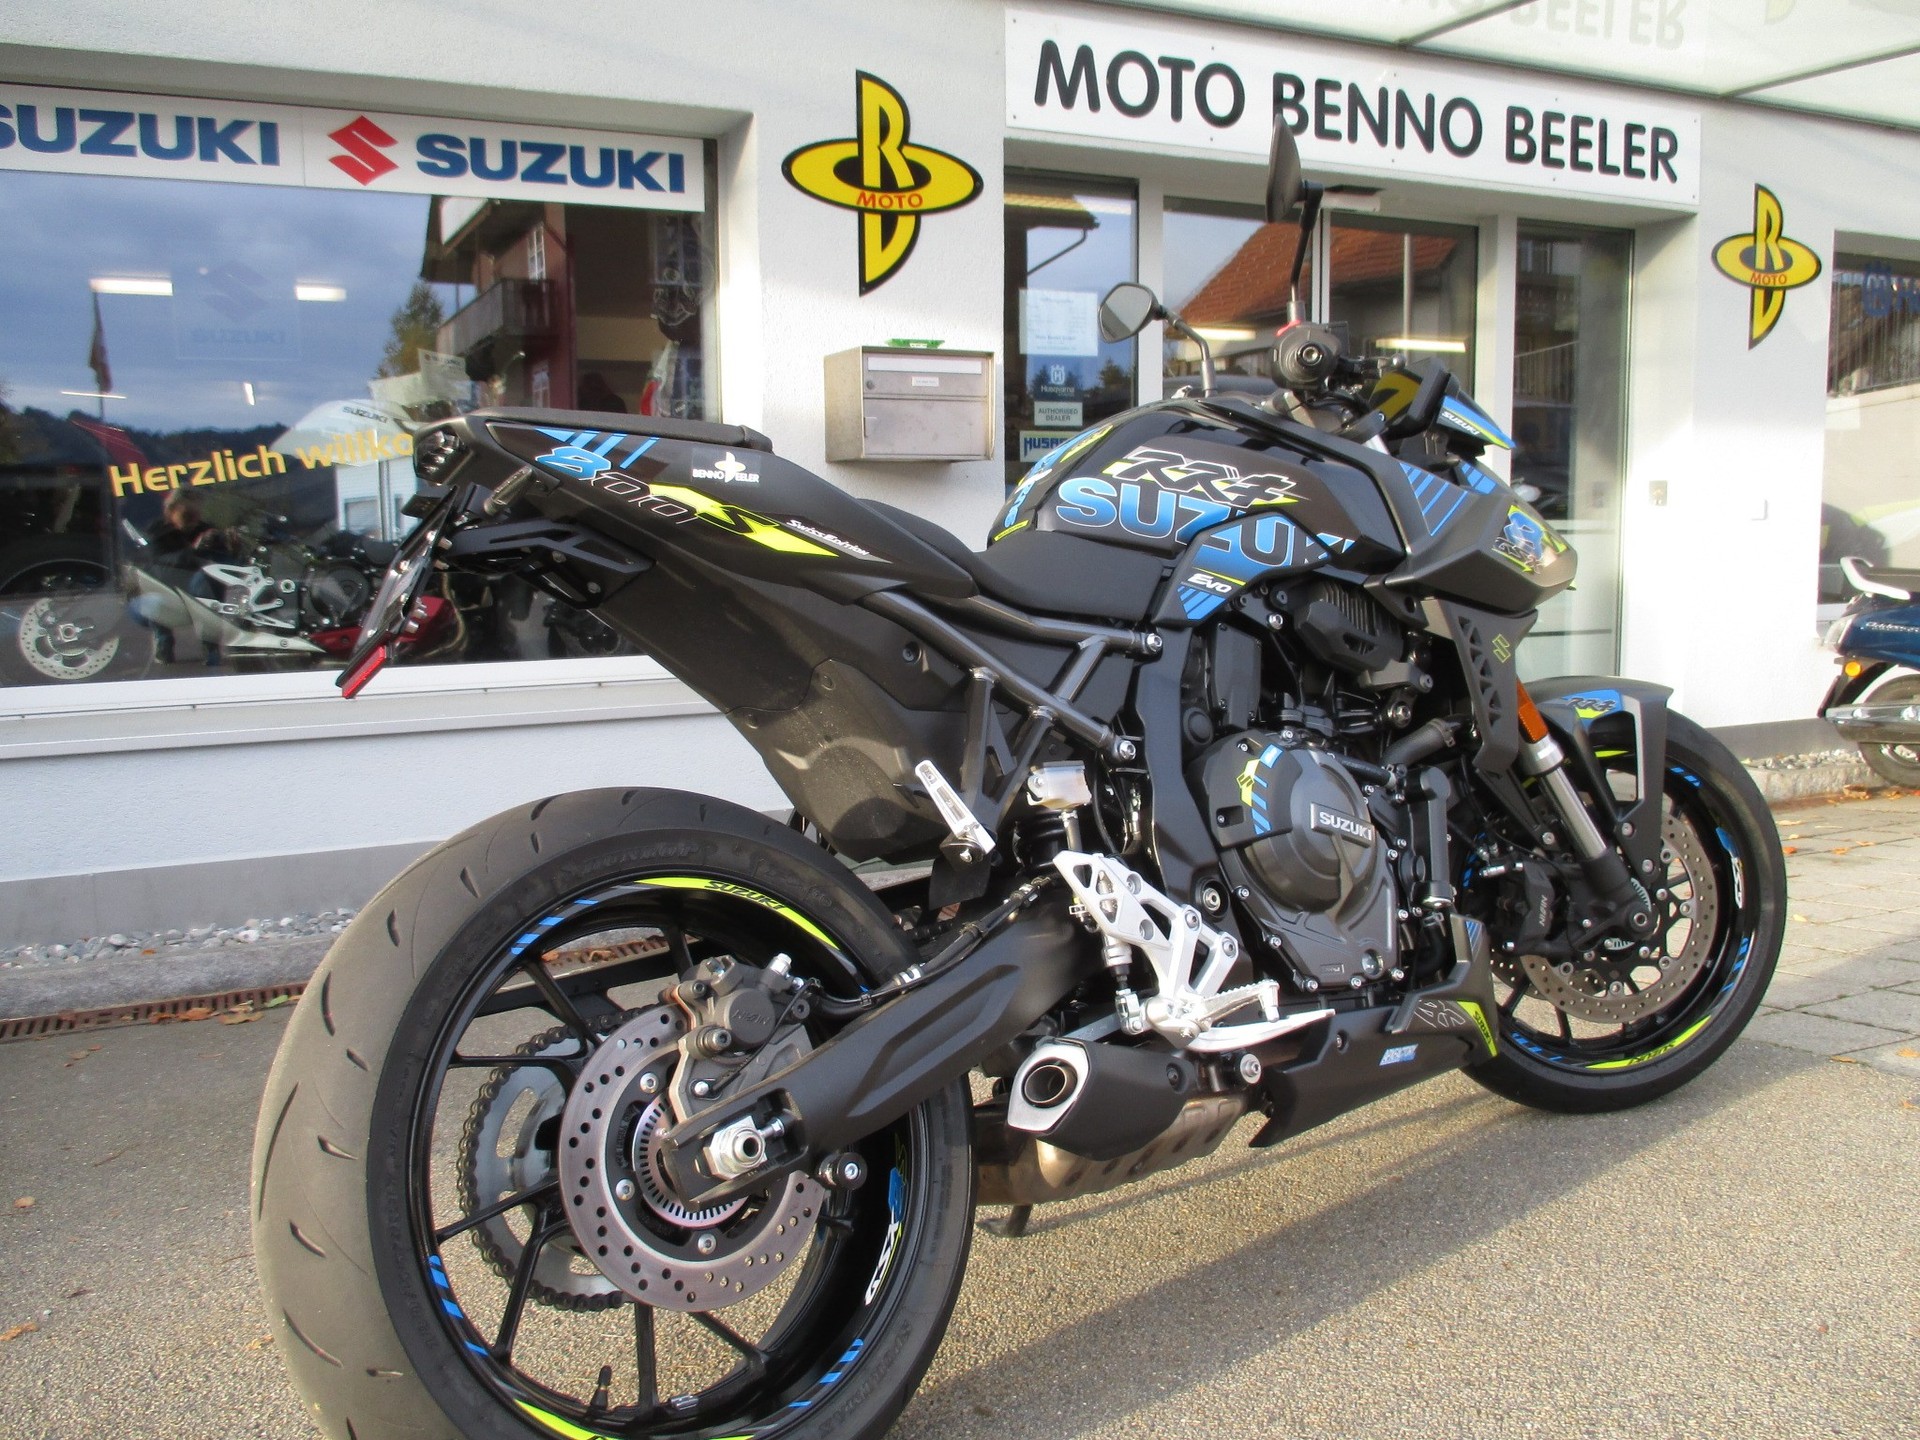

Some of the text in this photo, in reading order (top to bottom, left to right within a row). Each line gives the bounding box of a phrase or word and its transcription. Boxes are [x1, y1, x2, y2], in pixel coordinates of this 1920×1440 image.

[1034, 39, 1678, 184] MOTO BENNO BEELER
[0, 103, 280, 166] UZUKI
[416, 133, 685, 193] SUZUKI
[856, 191, 923, 209] MOTO
[1750, 271, 1787, 286] MOTO
[341, 405, 388, 424] SUZUKI
[1038, 407, 1079, 415] AUTHORISED
[1441, 410, 1480, 436] SUZUKI
[109, 444, 287, 497] Herzlich
[692, 468, 725, 481] BENNO
[1319, 811, 1372, 841] SUZUKI
[704, 880, 785, 911] SUZUKI
